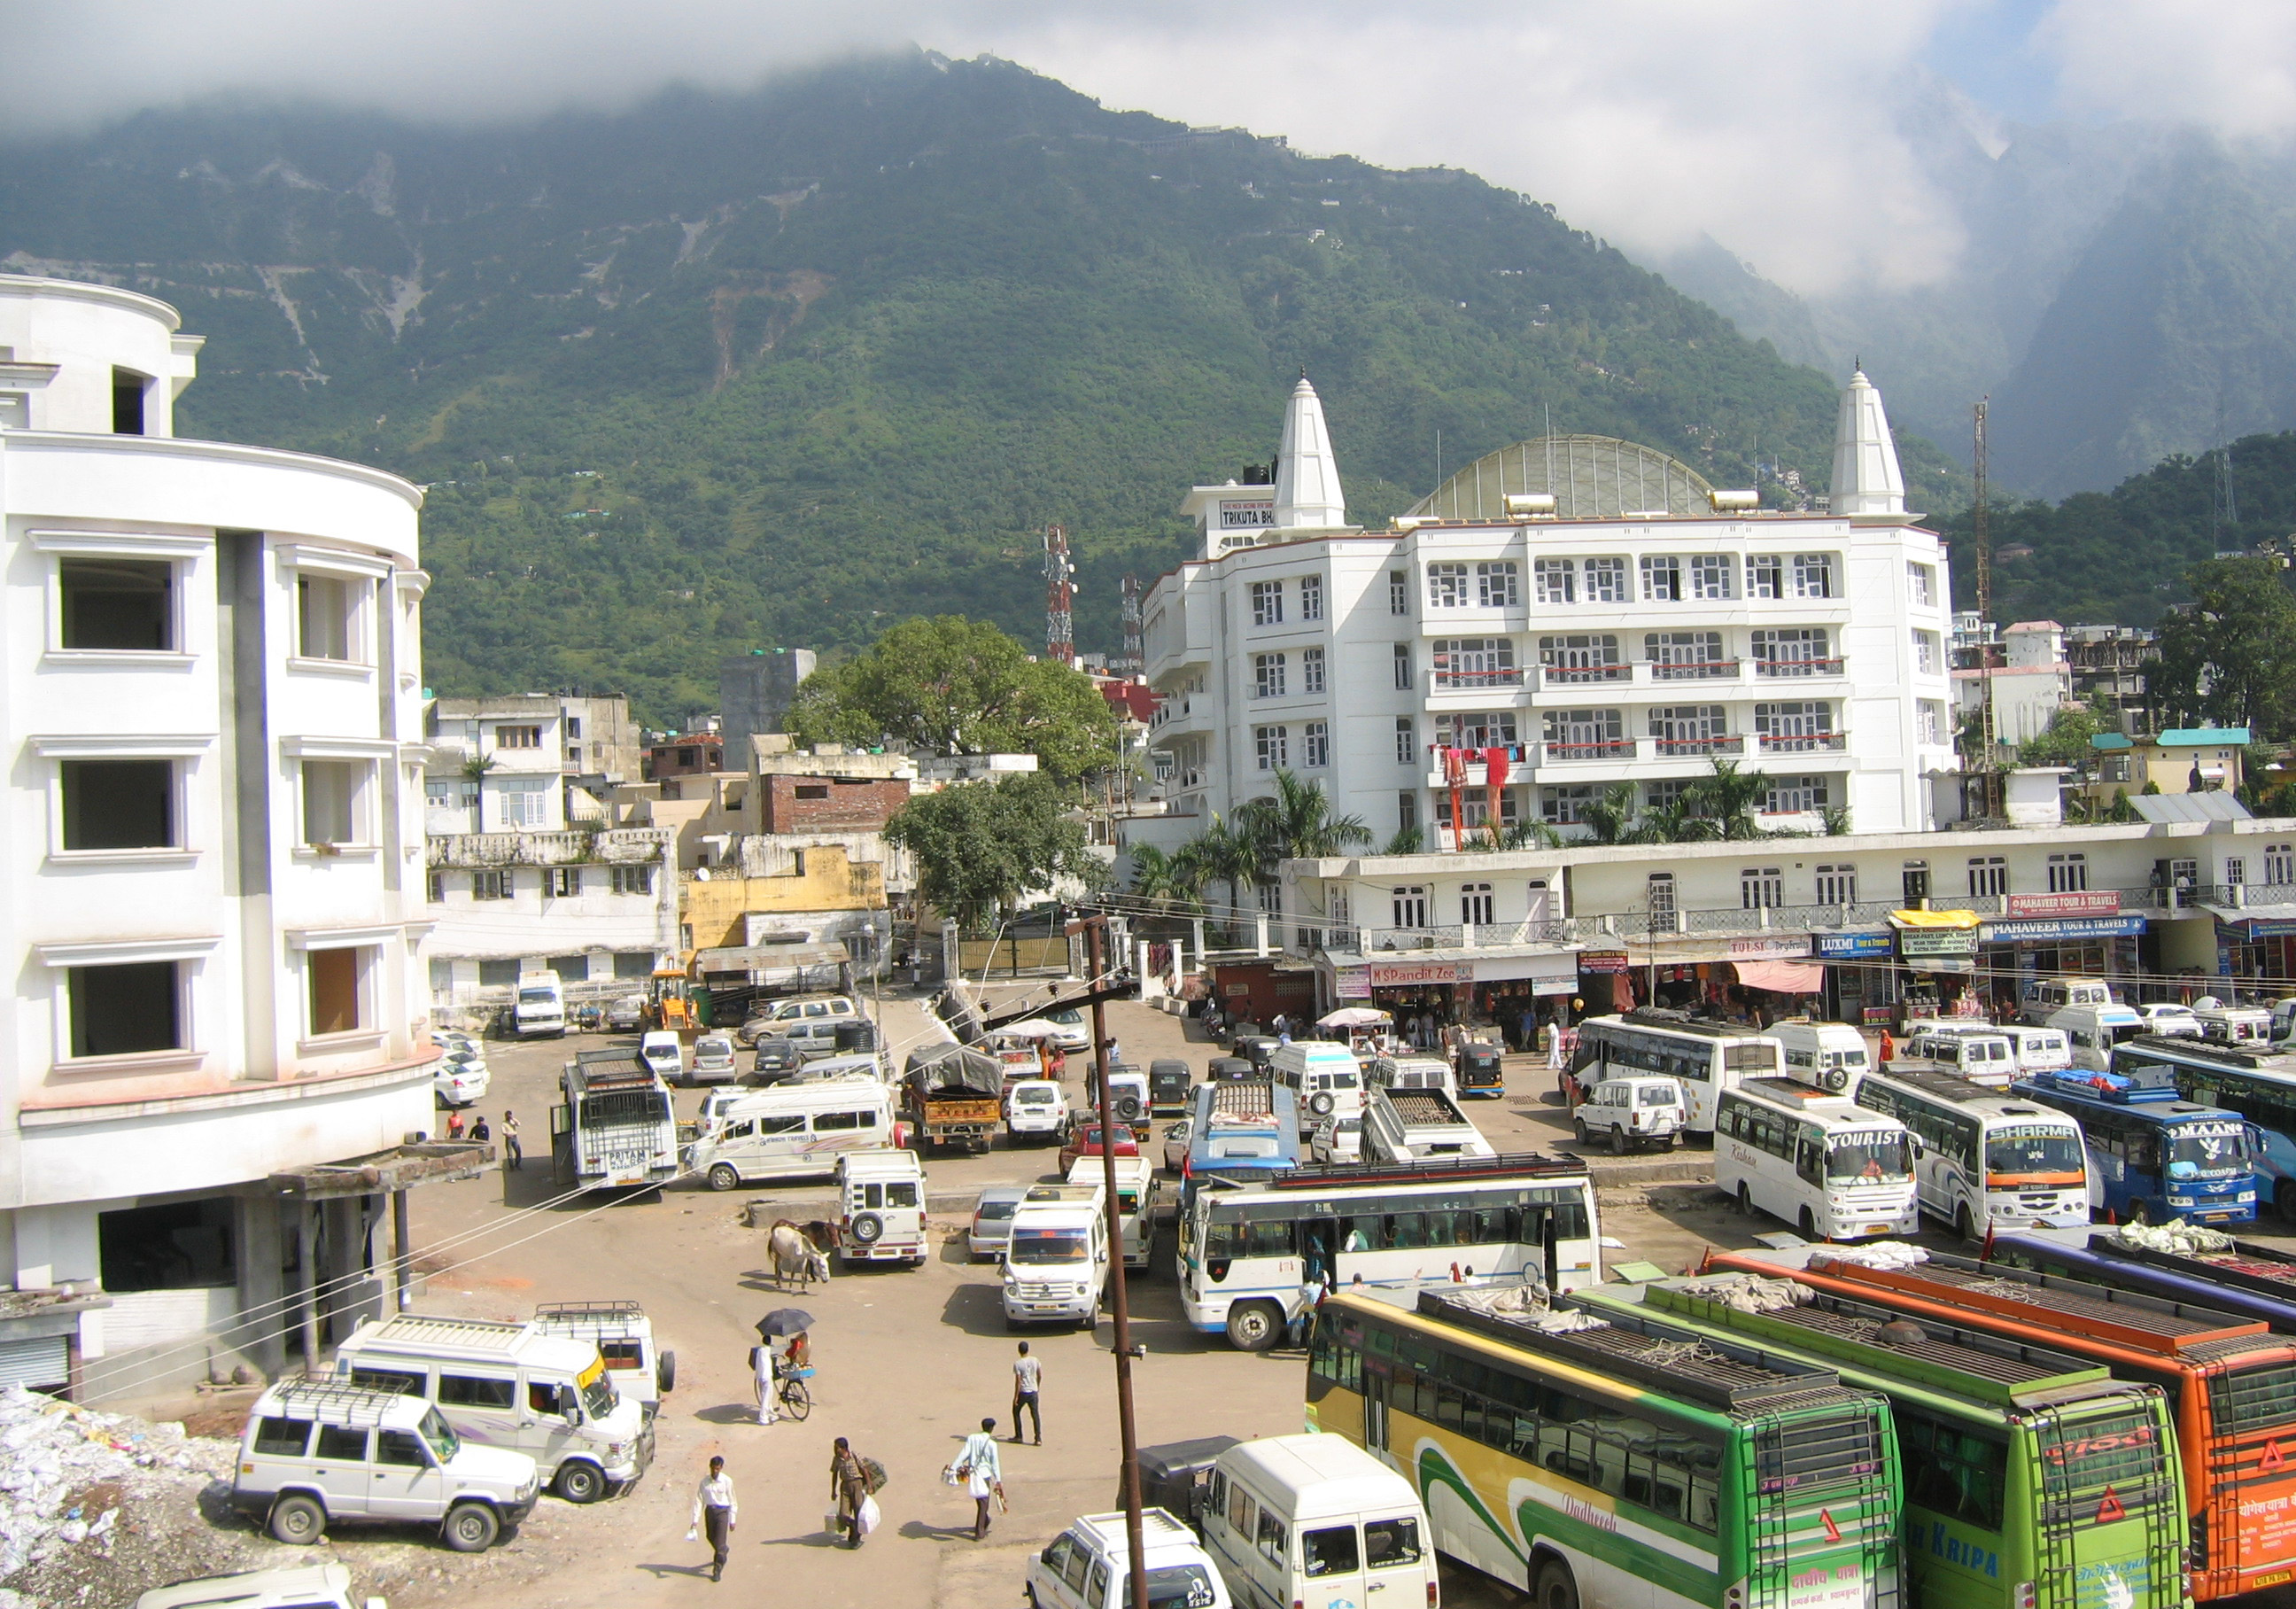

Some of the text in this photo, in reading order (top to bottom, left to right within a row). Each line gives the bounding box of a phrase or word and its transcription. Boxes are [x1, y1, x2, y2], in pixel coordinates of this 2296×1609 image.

[1223, 511, 1258, 525] TRIKUTA
[2020, 896, 2117, 908] MAHAVEER TOUR & TRAVELS
[1994, 922, 2060, 934] MAHAVEER
[2062, 921, 2083, 930] TOUR
[2094, 919, 2128, 929] TRAVELS
[1731, 941, 1765, 952] TULSI
[1821, 938, 1853, 951] LUXMI
[1990, 1126, 2075, 1139] SHARMA
[2178, 1123, 2236, 1137] MAAN
[1831, 1131, 1904, 1147] TOURIST
[2267, 1496, 2288, 1511] यात्रा
[1932, 1520, 1997, 1578] KRIPA
[1835, 1564, 1859, 1581] यात्रा
